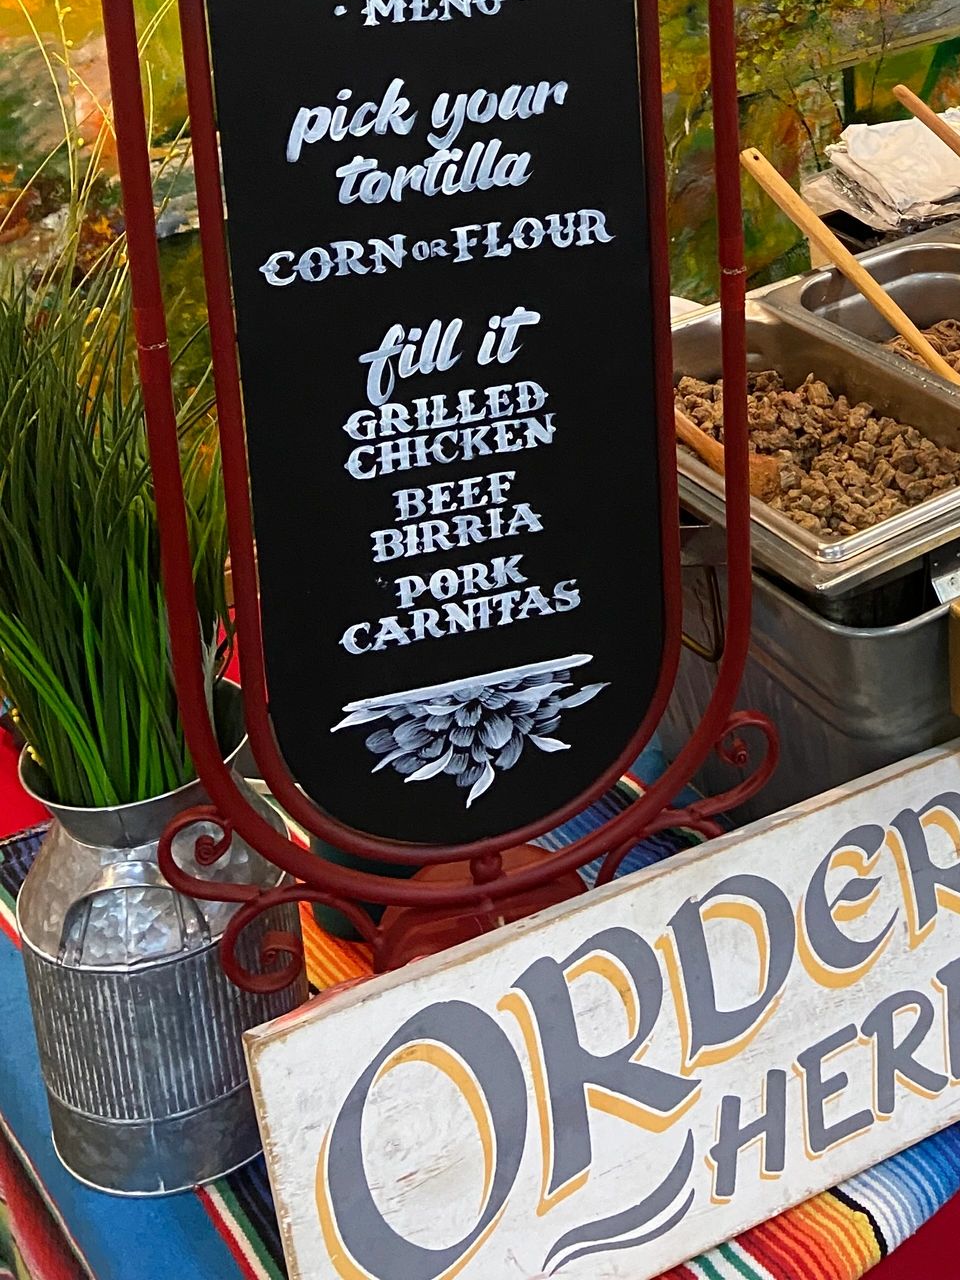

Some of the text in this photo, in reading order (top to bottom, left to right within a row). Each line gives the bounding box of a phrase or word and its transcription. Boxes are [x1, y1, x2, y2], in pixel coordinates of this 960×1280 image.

[287, 78, 569, 163] pick your
[335, 138, 534, 206] tortilla
[259, 208, 617, 287] CORN OR FLOUR
[359, 306, 541, 405] fill it
[342, 380, 550, 441] GRILLED
[343, 412, 557, 480] CHICKEN
[392, 470, 517, 521] BEEF
[370, 502, 544, 563] BIRRIA
[393, 554, 528, 609] PORK
[339, 579, 583, 655] CARNITAS
